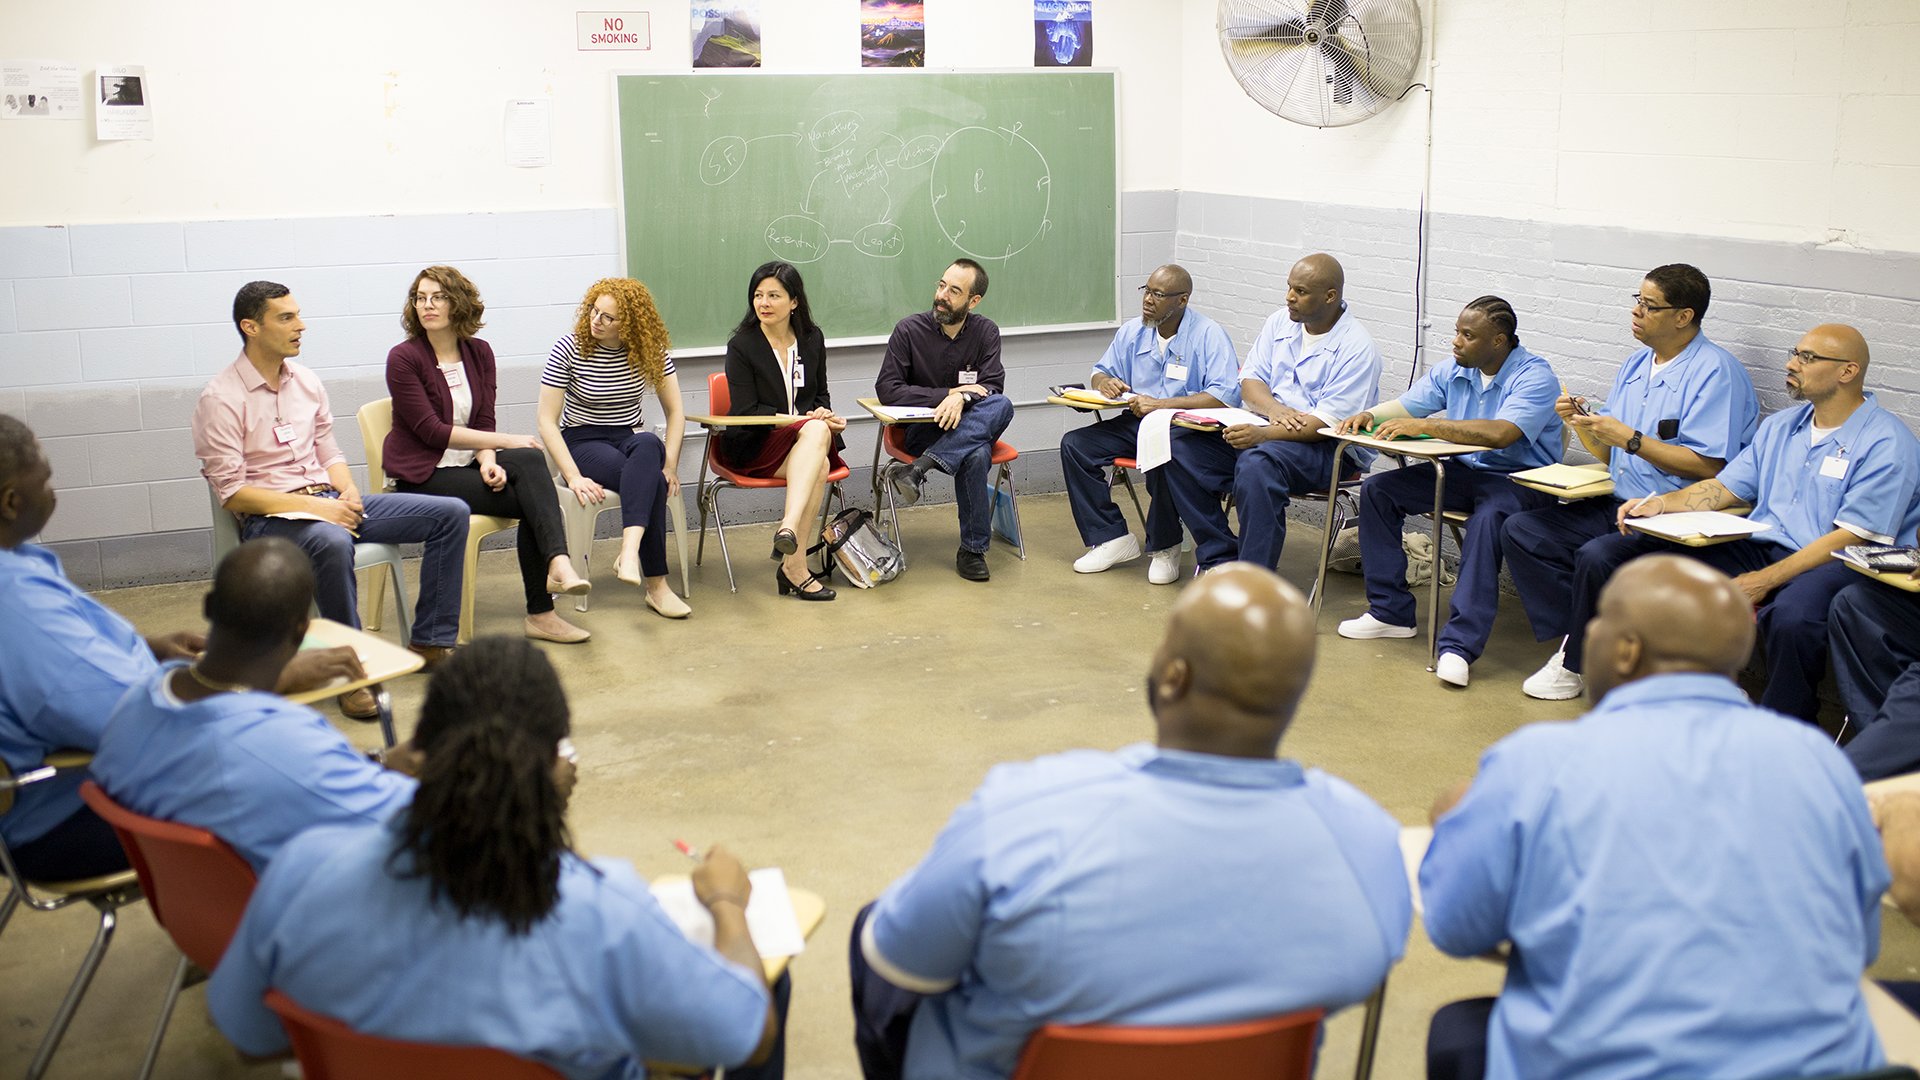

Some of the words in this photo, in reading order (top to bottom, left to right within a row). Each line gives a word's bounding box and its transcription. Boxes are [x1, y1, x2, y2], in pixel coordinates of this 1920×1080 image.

[1037, 2, 1089, 12] IMAGINATION
[604, 17, 624, 31] NO
[591, 33, 638, 44] SMOKING
